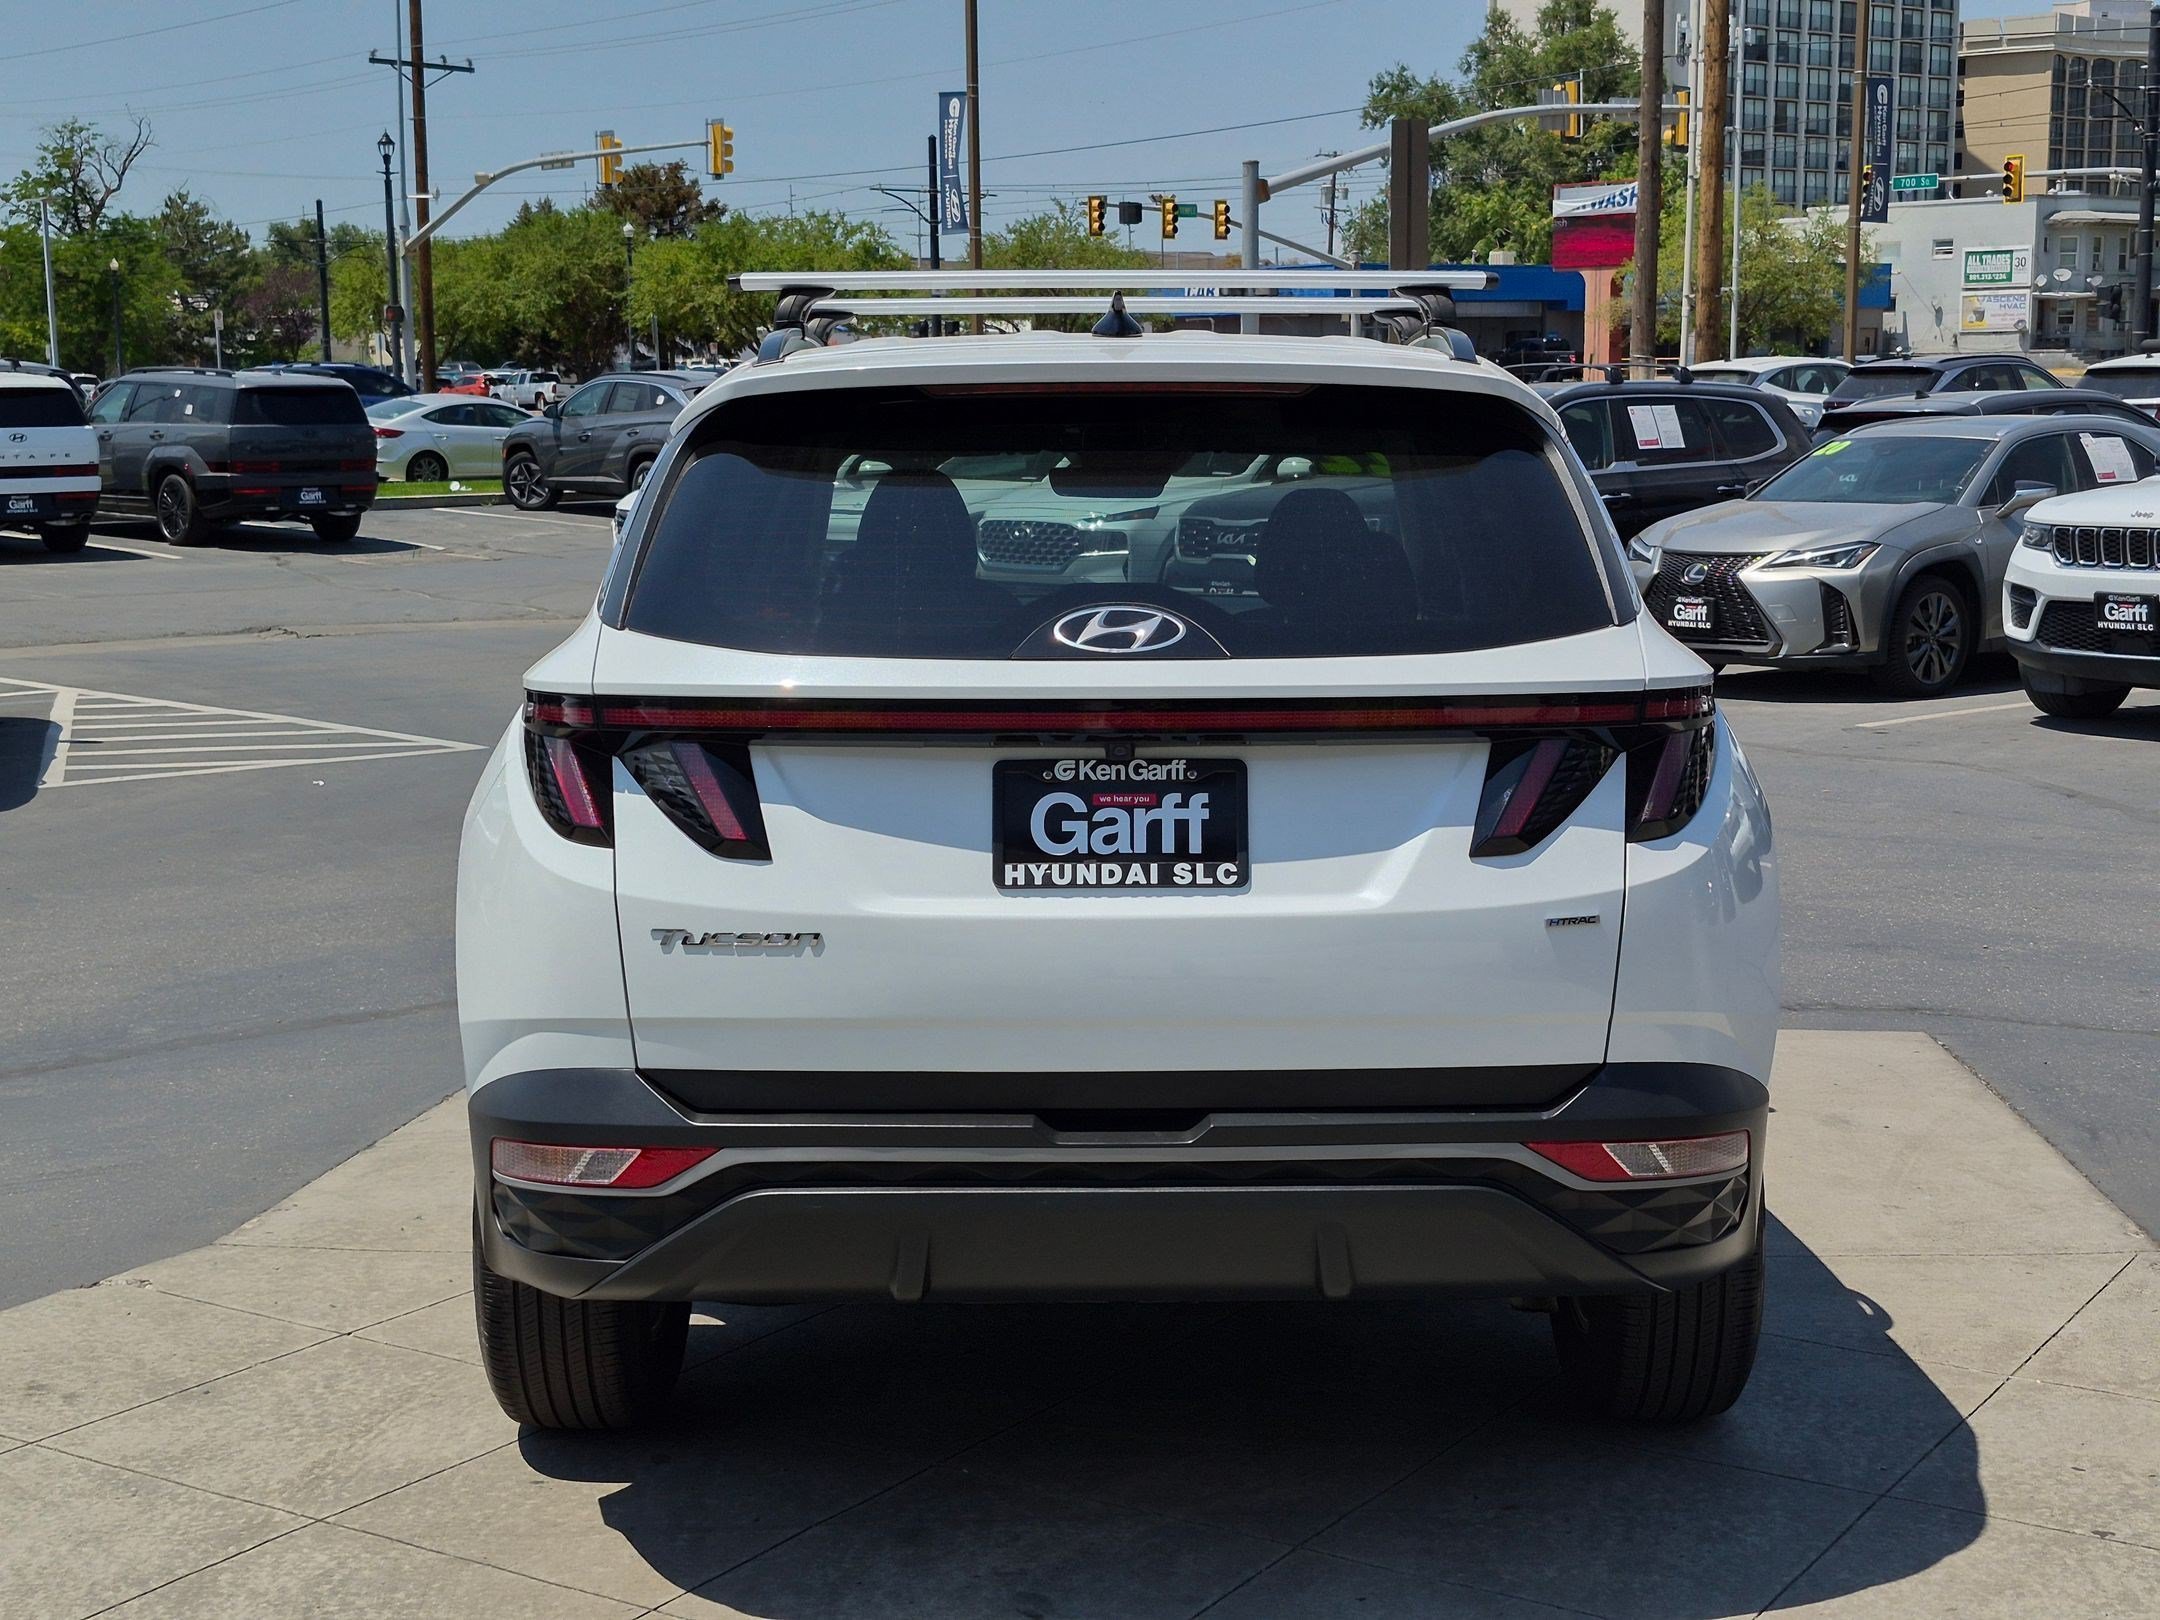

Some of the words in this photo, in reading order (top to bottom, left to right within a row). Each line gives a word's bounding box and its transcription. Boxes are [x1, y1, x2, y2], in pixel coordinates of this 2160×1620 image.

[1900, 178, 1916, 187] 700
[1967, 254, 1980, 265] ALL
[1982, 253, 2011, 265] TRADES
[2014, 257, 2027, 268] 30
[2000, 302, 2026, 310] HVAC
[1673, 603, 1708, 621] Garff
[2104, 602, 2148, 622] Garff
[1667, 620, 1697, 628] HYUNDAI
[2097, 621, 2135, 630] HYUNDAI
[2137, 623, 2154, 631] SLC
[1079, 760, 1126, 780] Ken
[1128, 760, 1187, 780] Garff
[1133, 796, 1150, 804] you
[1030, 792, 1210, 856] Garff
[1004, 863, 1159, 886] HYUNDAI
[1172, 862, 1239, 885] SLC
[1546, 915, 1598, 927] HTRAC
